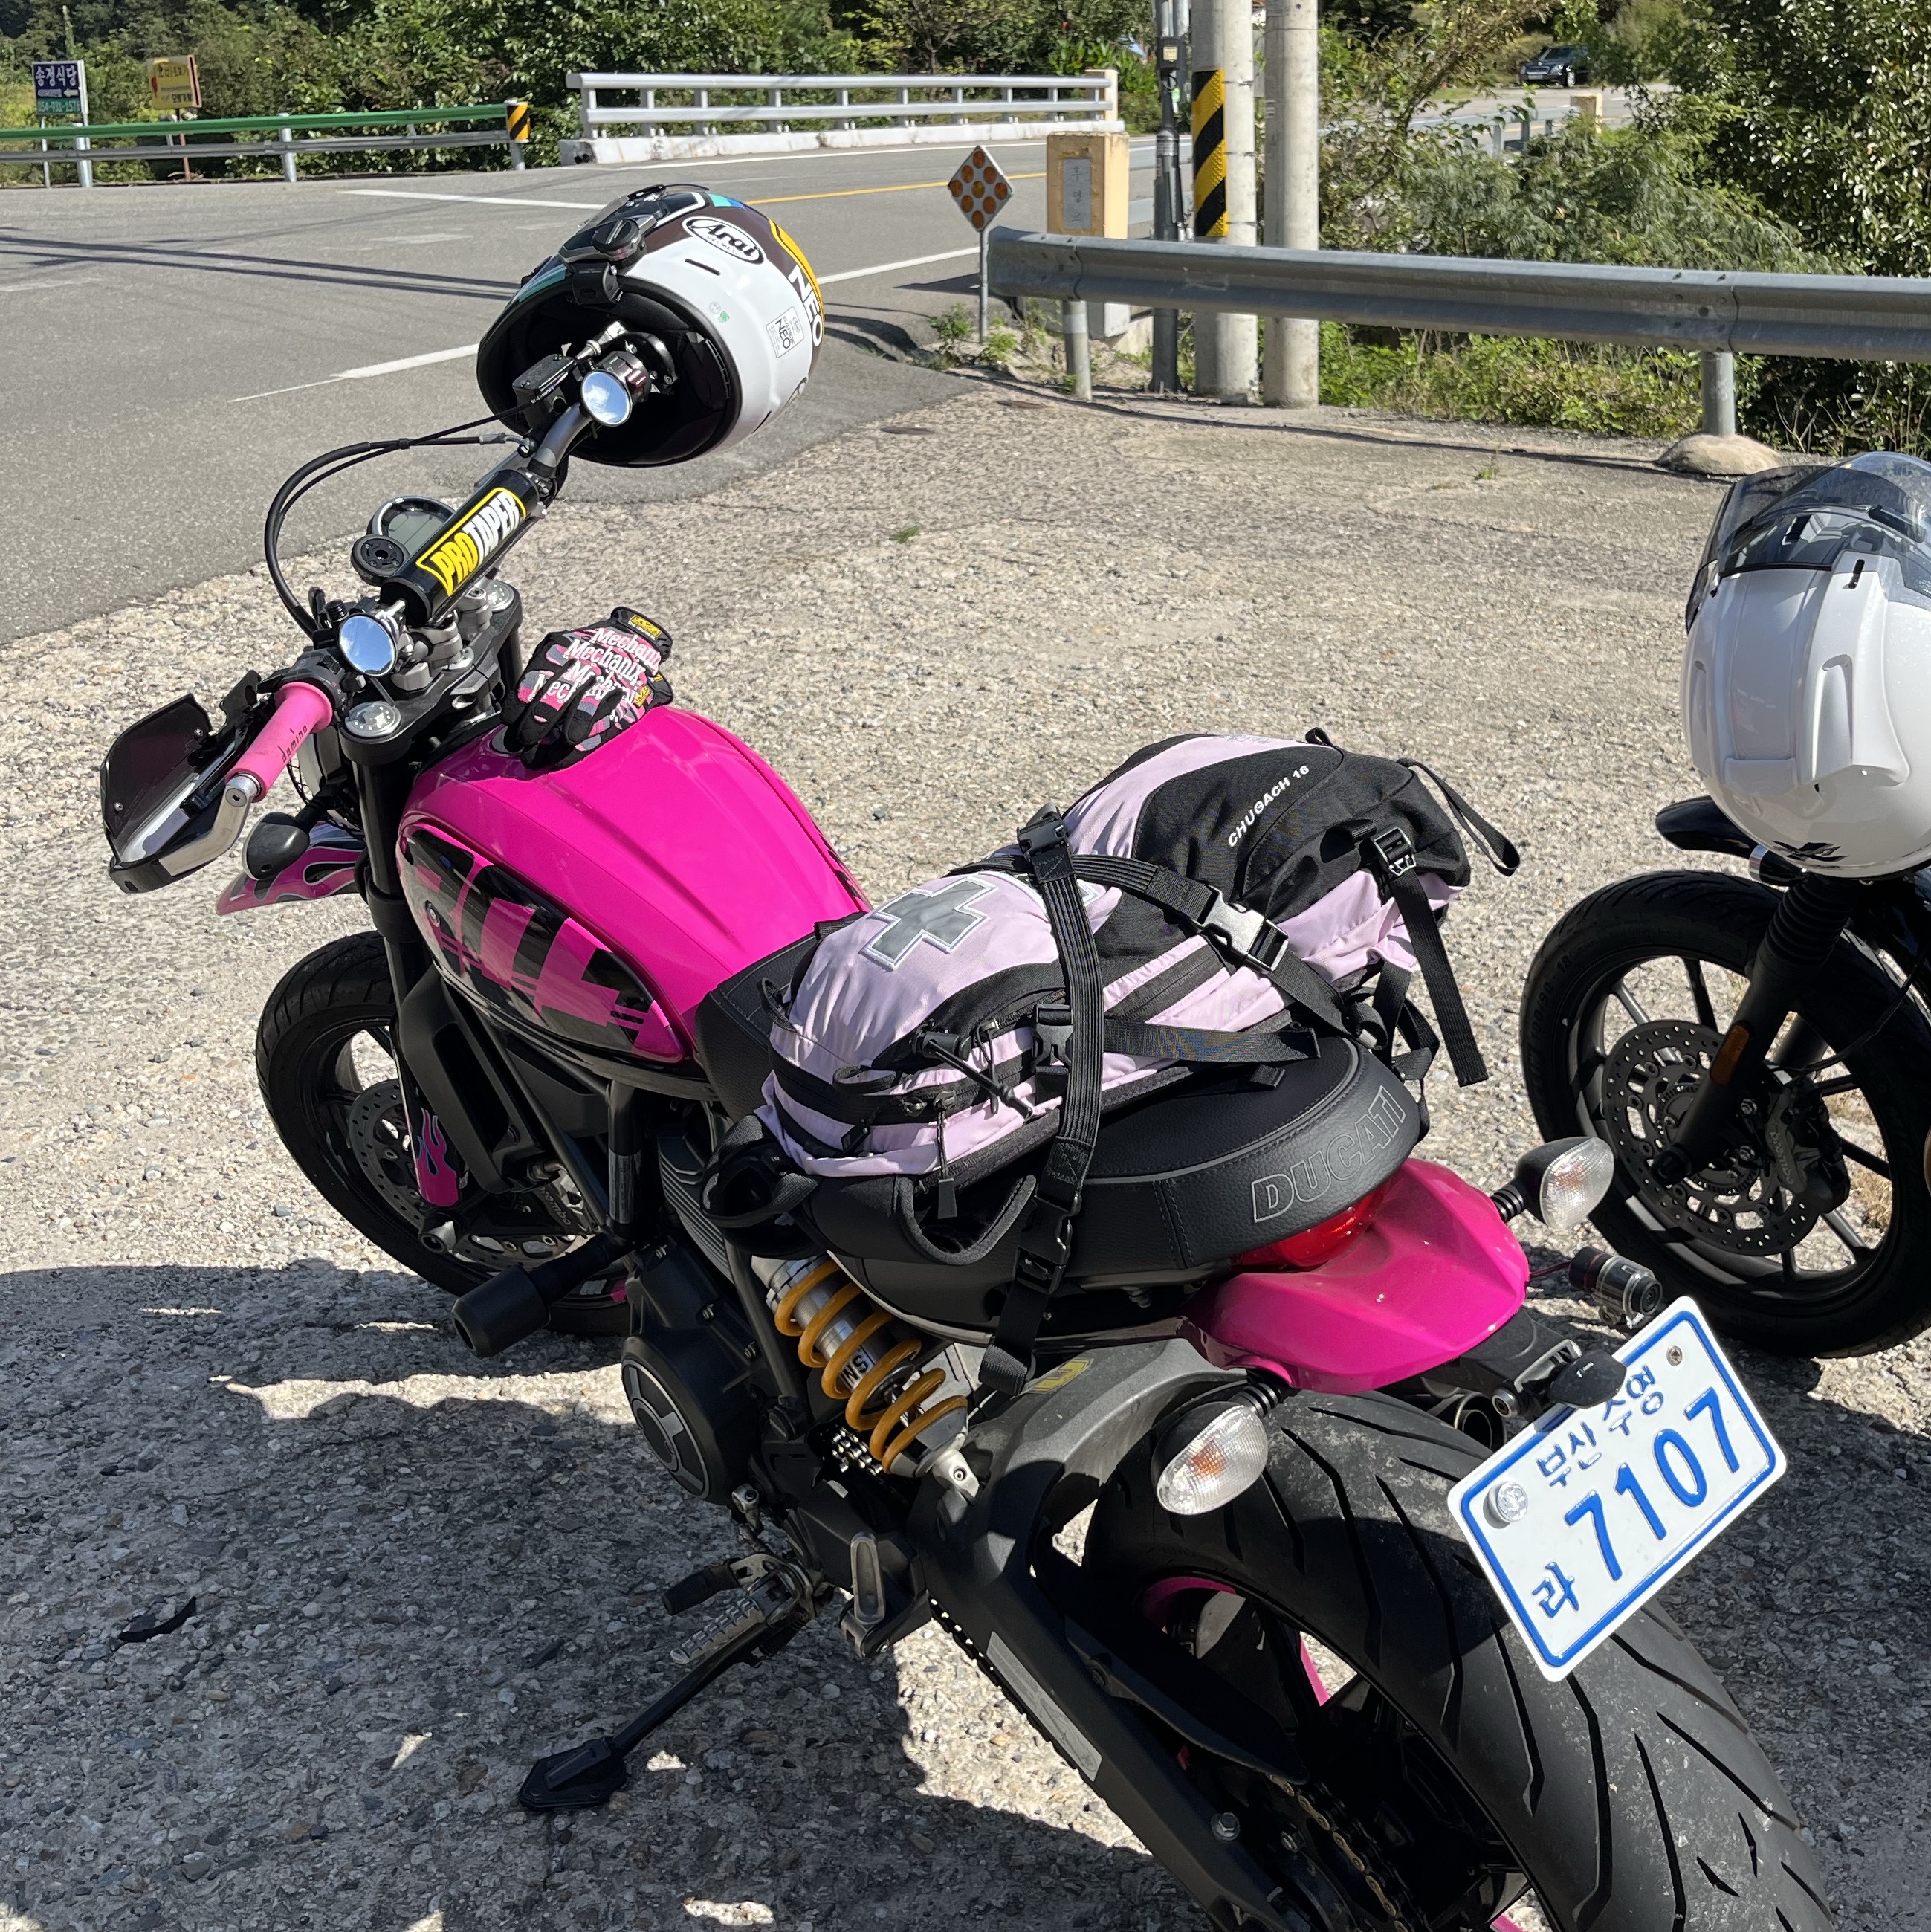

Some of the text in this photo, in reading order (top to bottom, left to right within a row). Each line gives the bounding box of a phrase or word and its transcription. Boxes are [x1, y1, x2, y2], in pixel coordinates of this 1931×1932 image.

[36, 65, 77, 87] 송정식당
[688, 224, 760, 257] Arai
[775, 318, 791, 349] NEO
[788, 264, 823, 347] NEO
[278, 724, 308, 763] domino
[1229, 765, 1310, 847] CHUGACH 16
[1251, 1085, 1406, 1223] DUCATI
[1536, 1365, 1664, 1487] 부산 수영
[1532, 1387, 1740, 1618] 라 7107
